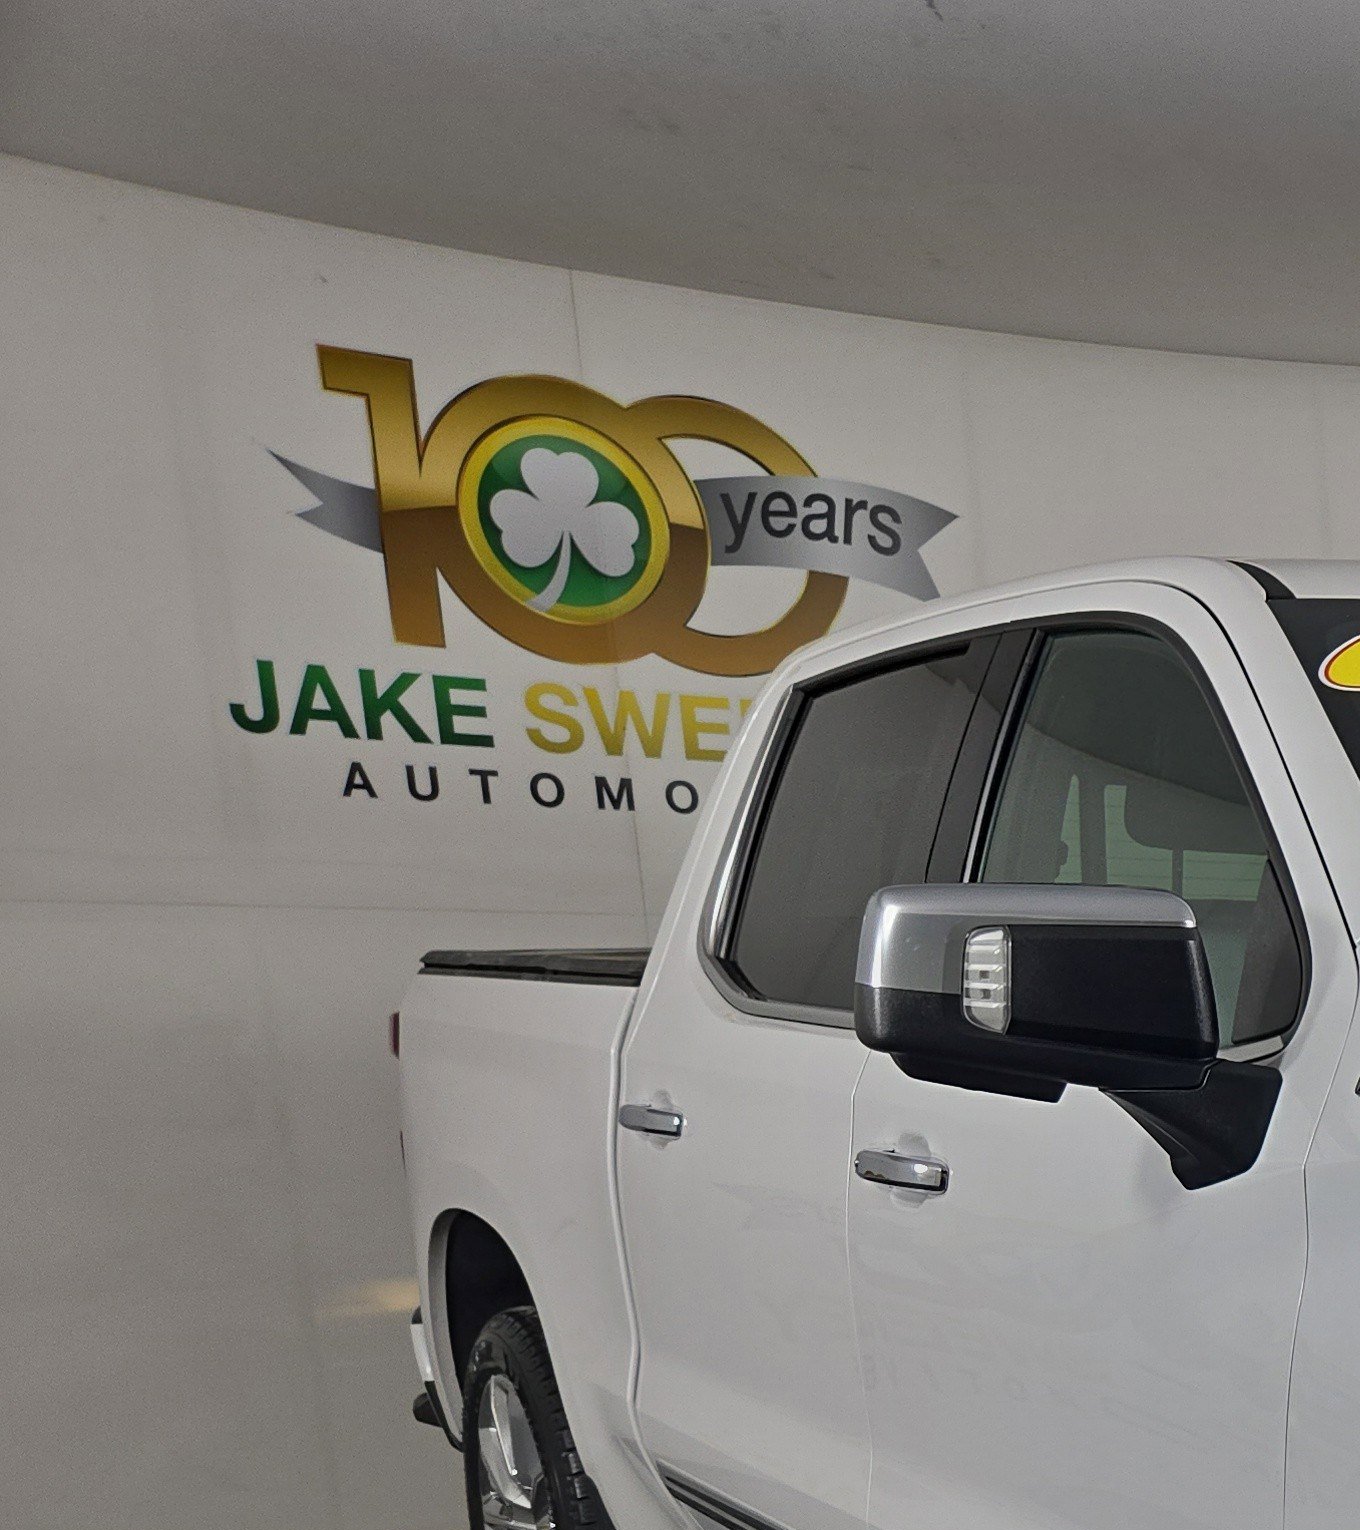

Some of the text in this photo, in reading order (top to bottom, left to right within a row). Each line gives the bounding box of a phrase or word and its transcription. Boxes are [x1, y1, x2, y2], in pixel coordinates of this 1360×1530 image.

[718, 486, 904, 557] years
[228, 658, 755, 763] JAKE SWE
